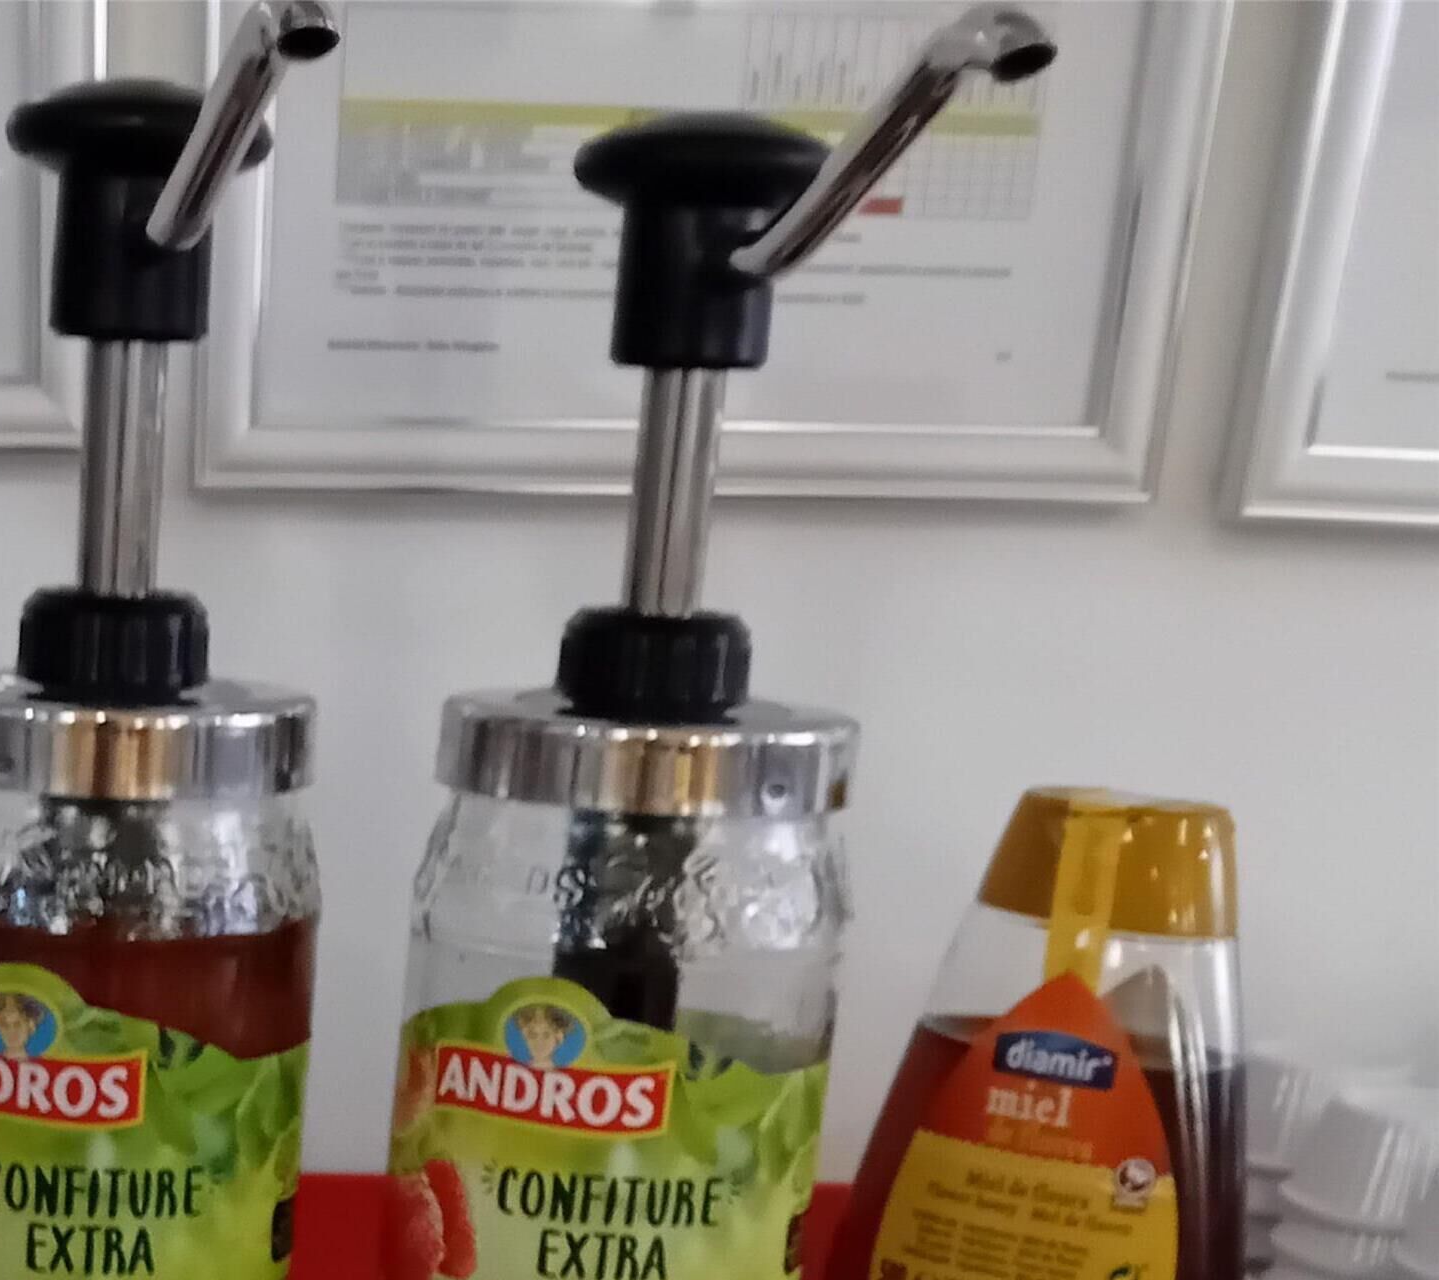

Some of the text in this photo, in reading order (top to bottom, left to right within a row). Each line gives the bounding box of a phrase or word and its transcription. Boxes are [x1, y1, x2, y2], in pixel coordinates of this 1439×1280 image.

[1006, 1040, 1097, 1080] diamir
[438, 1053, 657, 1129] ANDROS
[985, 1082, 1072, 1128] miel
[497, 1167, 726, 1228] CONFITURE
[25, 1223, 155, 1277] EXTRA
